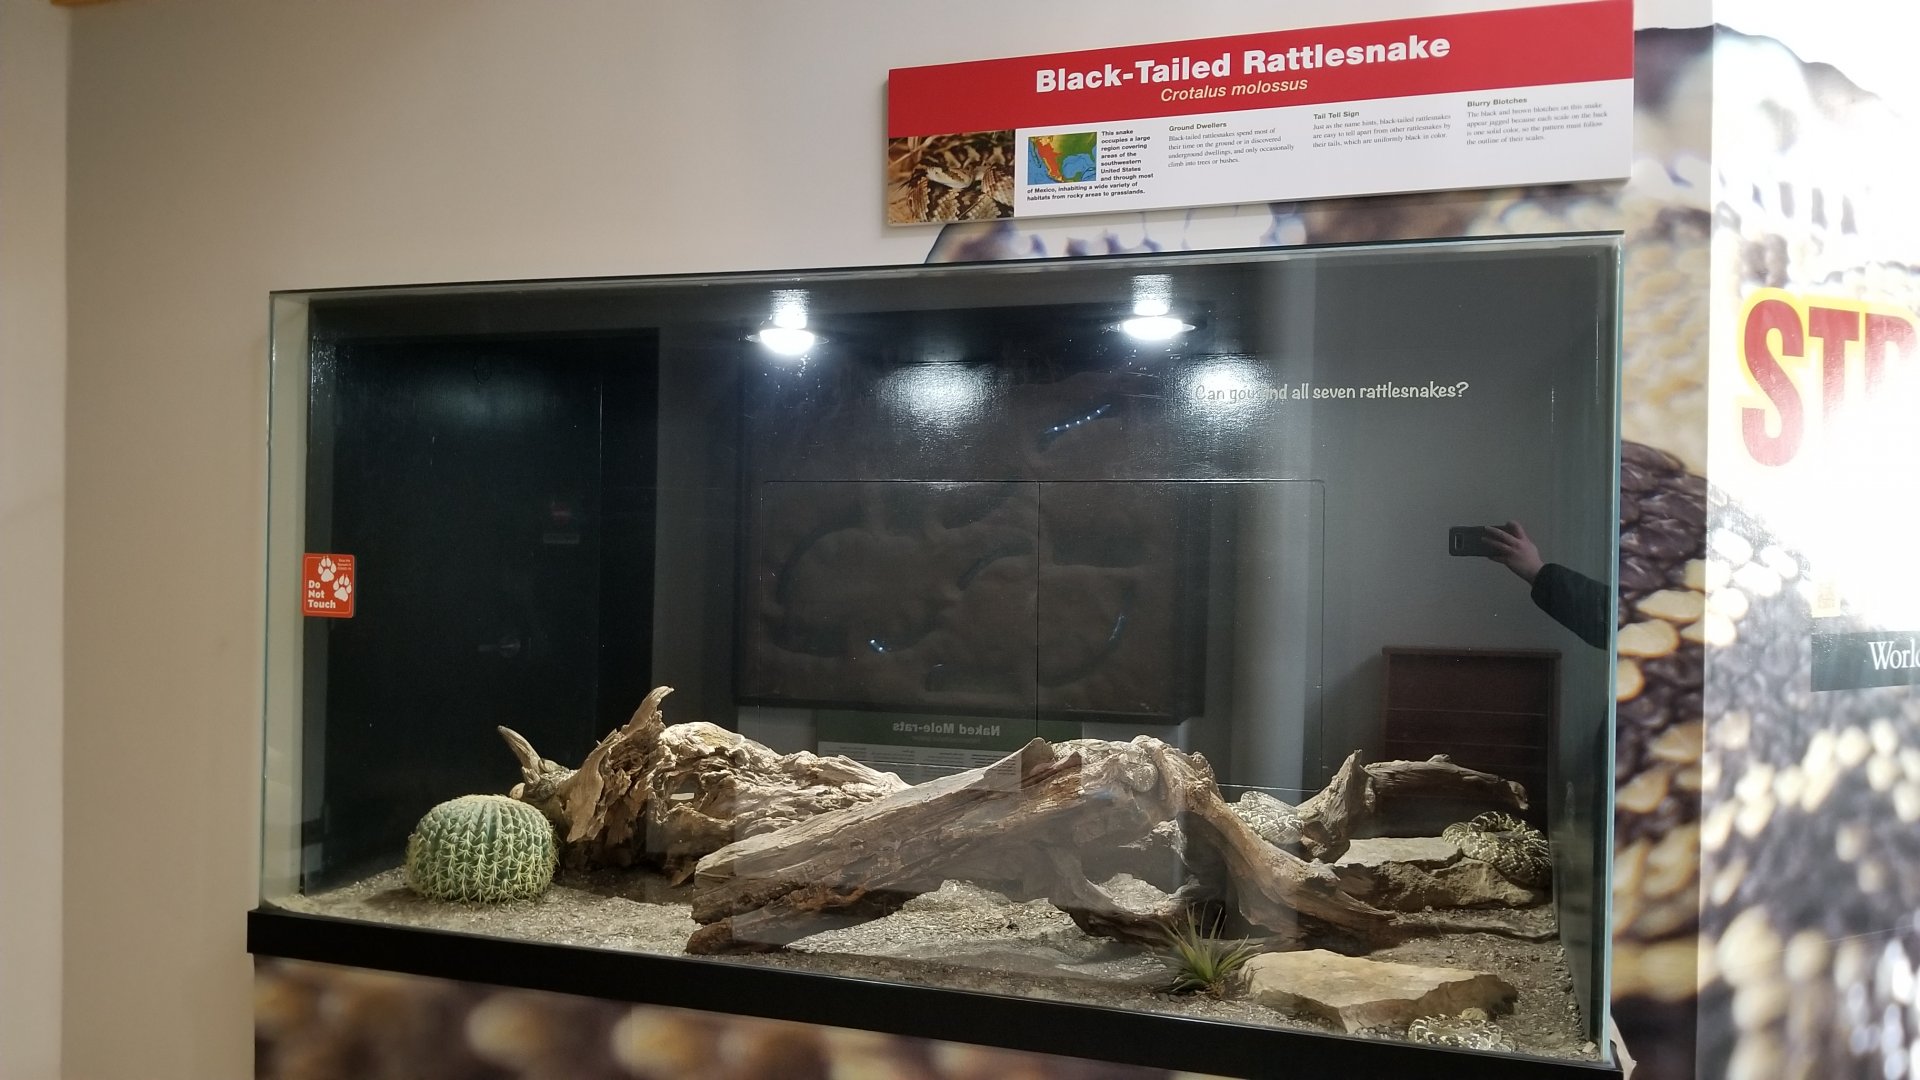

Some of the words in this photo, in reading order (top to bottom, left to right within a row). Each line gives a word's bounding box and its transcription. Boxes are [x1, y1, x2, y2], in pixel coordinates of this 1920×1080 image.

[1036, 53, 1230, 93] Black-Tailed
[1244, 35, 1450, 73] Rattlesnake
[1160, 87, 1226, 102] Crotalus
[1231, 78, 1308, 97] molossus
[1416, 114, 1451, 122] rattlesnakes
[1260, 144, 1294, 152] occasionally
[1196, 385, 1225, 400] Can
[1292, 383, 1309, 400] all
[1313, 387, 1356, 399] seven
[1360, 381, 1470, 399] rattlesnakes?
[309, 580, 320, 588] Do
[308, 590, 325, 598] Not
[308, 600, 336, 608] Touch
